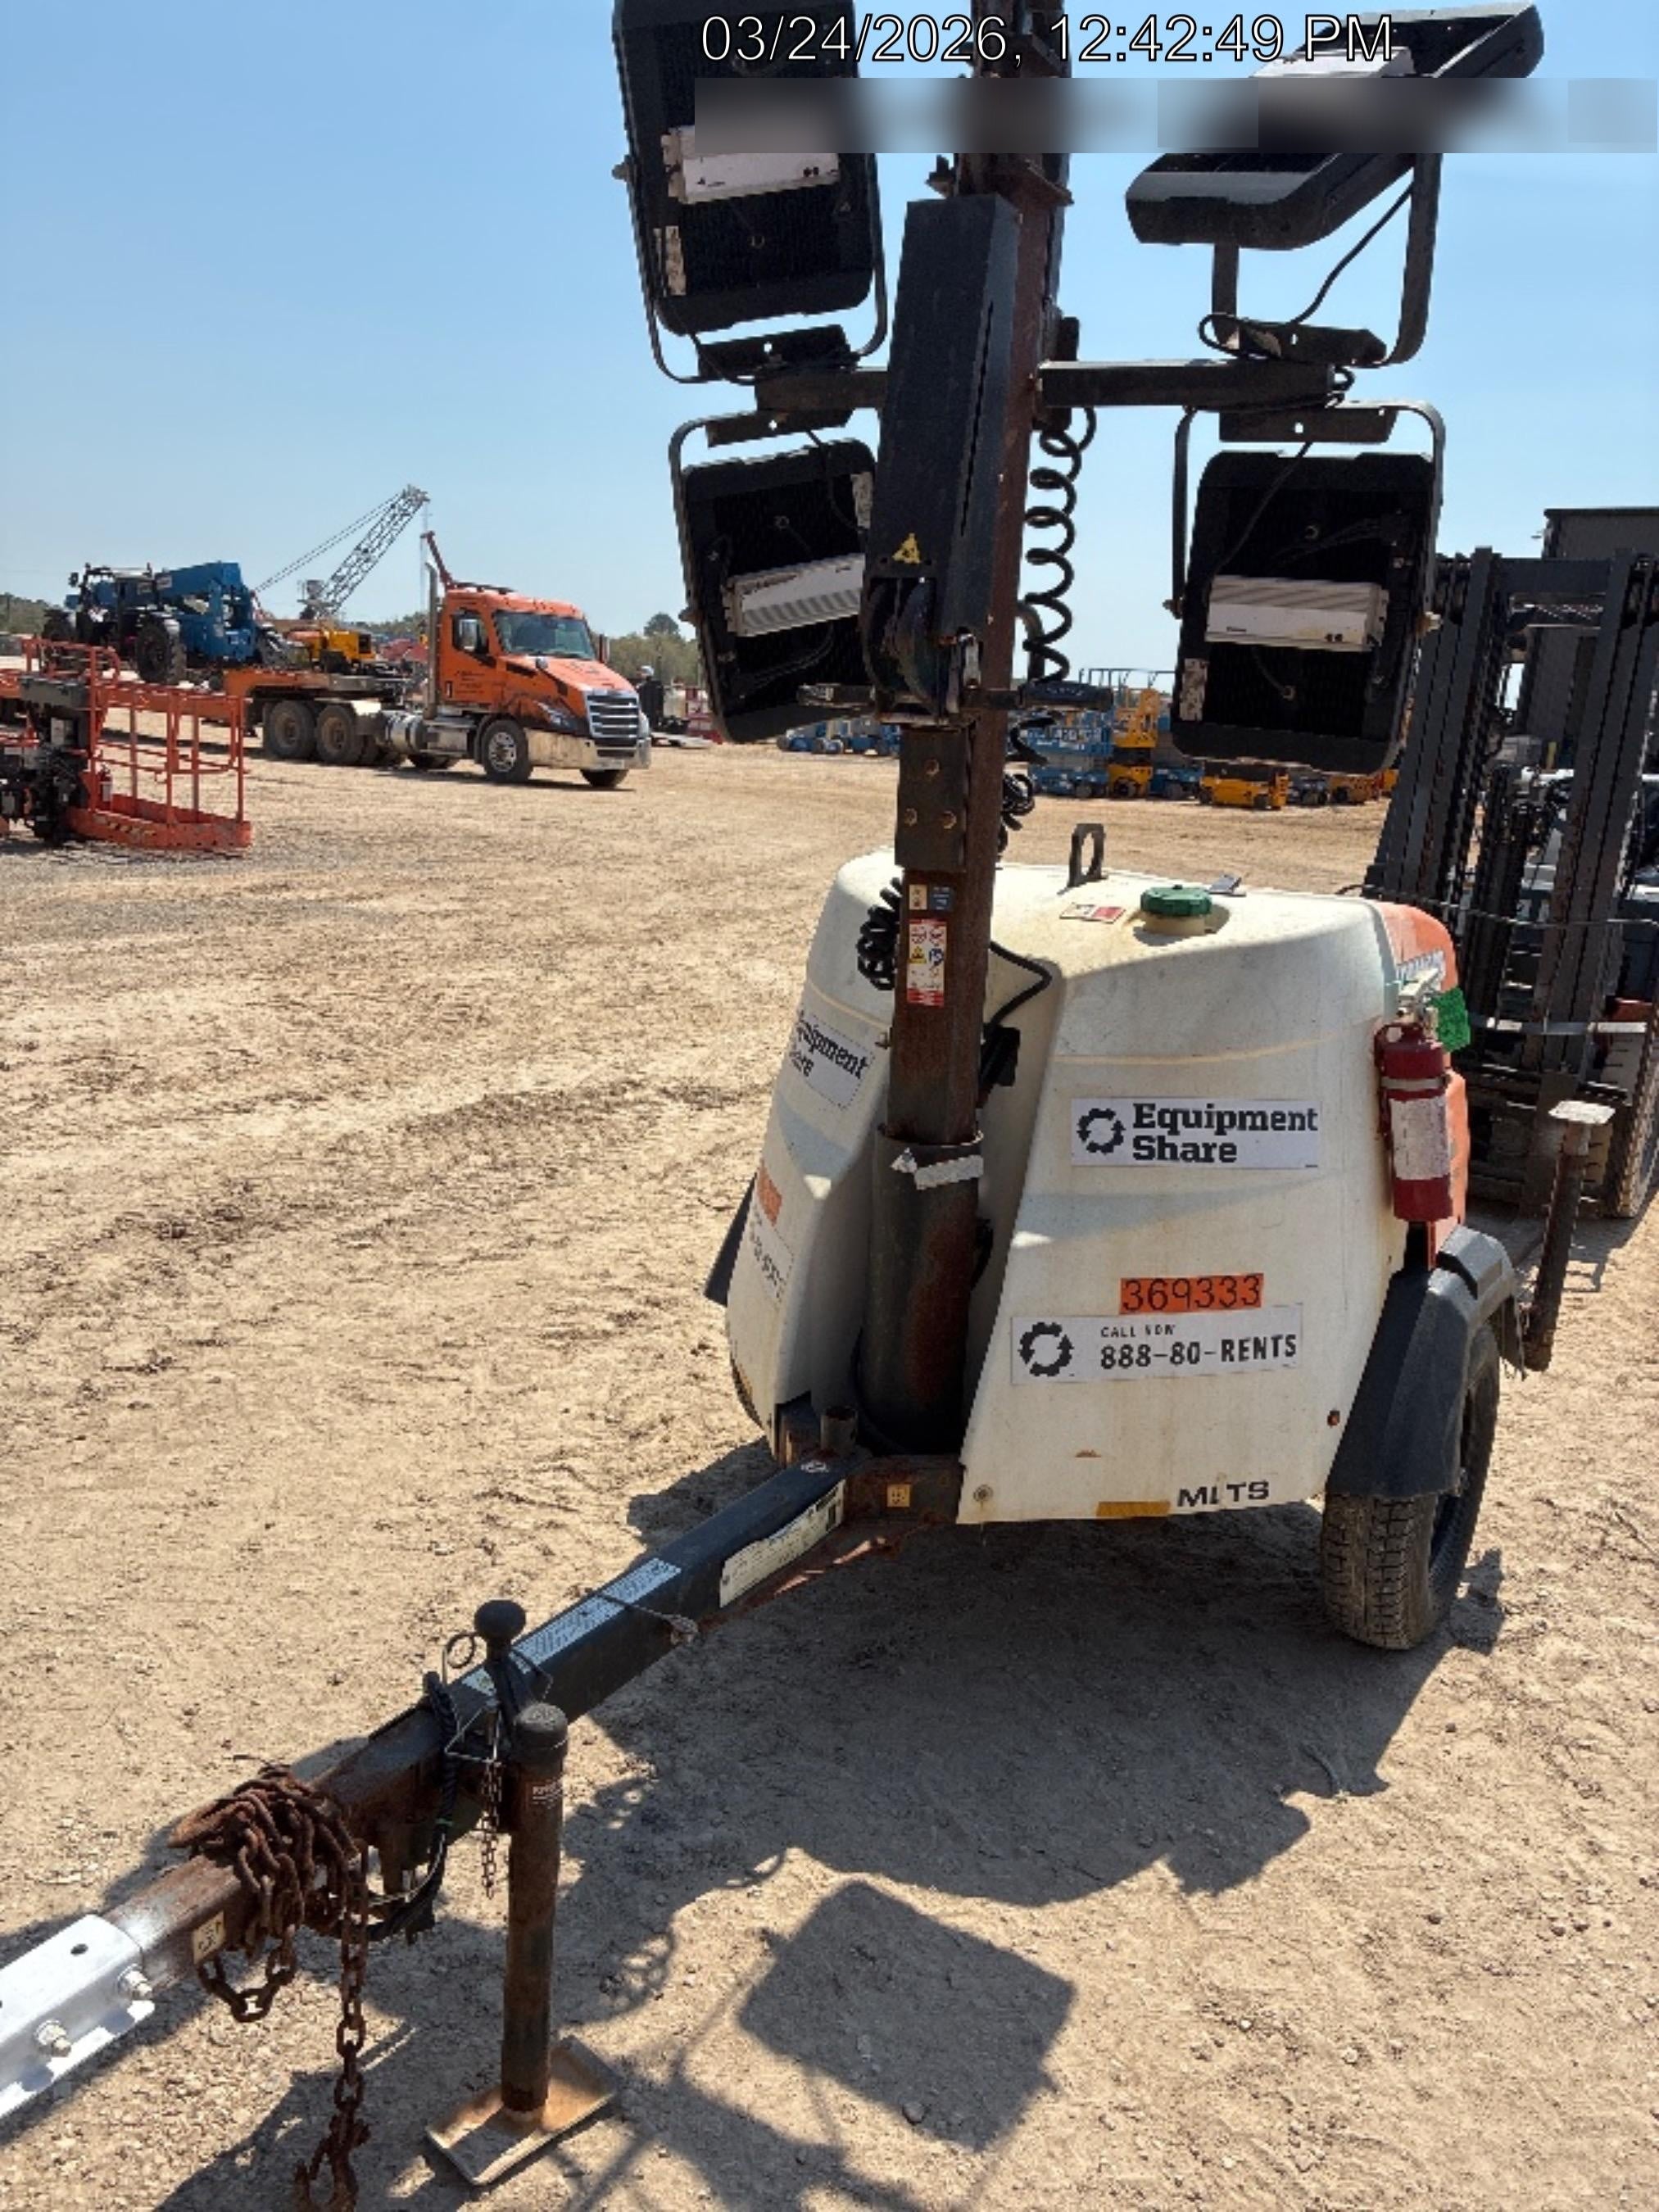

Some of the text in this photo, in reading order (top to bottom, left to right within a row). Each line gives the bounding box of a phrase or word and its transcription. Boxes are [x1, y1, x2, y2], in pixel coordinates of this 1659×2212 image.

[1132, 1103, 1318, 1136] Equipment
[1132, 1135, 1237, 1163] Share
[1122, 1275, 1260, 1312] 369333
[1100, 1326, 1136, 1338] CALL
[1100, 1334, 1297, 1370] 888-80-RENTS
